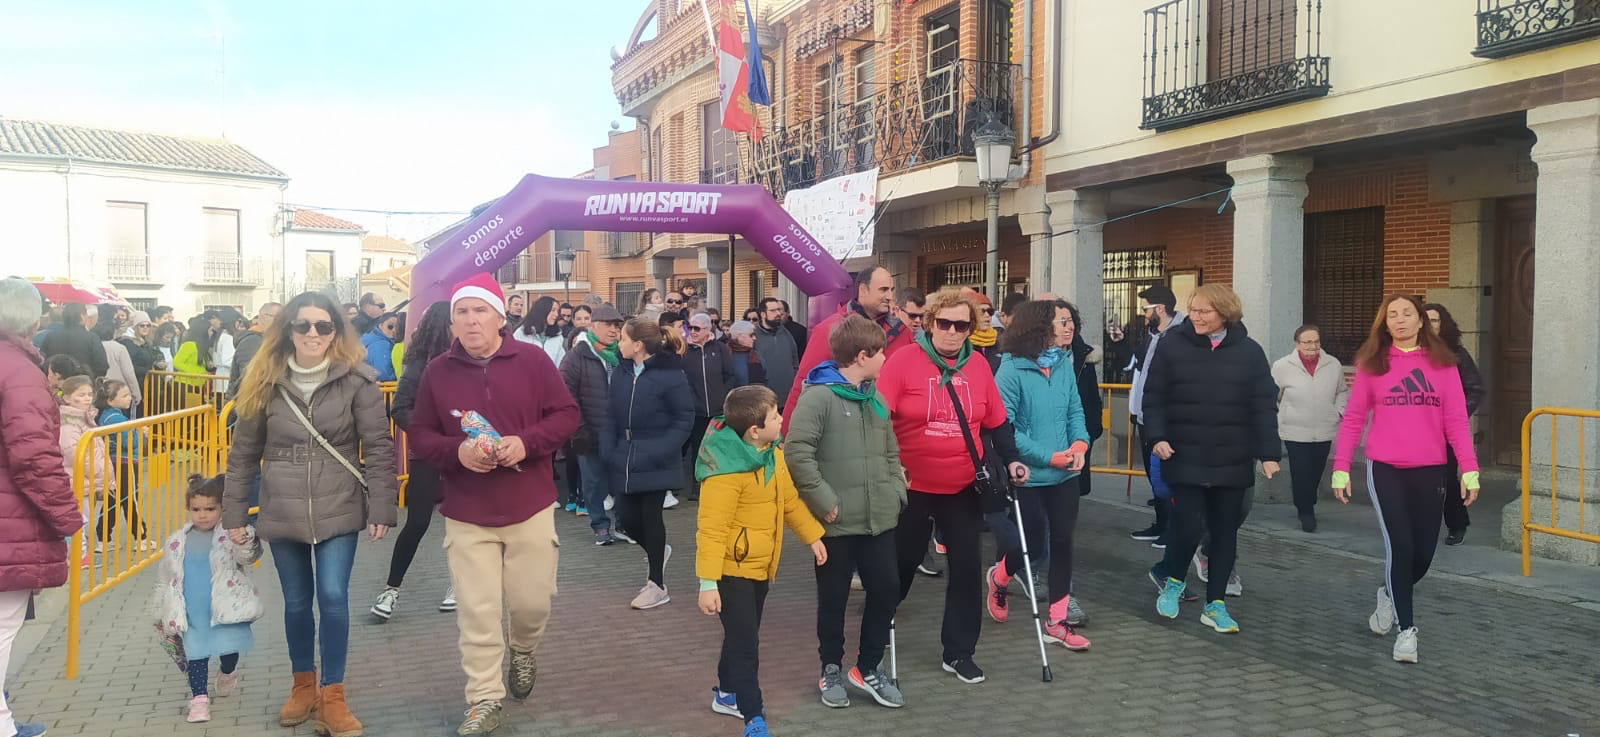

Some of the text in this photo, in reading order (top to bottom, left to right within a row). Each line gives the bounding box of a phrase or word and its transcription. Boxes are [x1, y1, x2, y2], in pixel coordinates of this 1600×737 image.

[462, 214, 504, 249] somos
[619, 215, 689, 223] www.runvasport.es
[474, 225, 524, 267] deporte
[773, 235, 815, 273] deporte
[788, 223, 822, 256] somos
[1383, 392, 1441, 407] adidas
